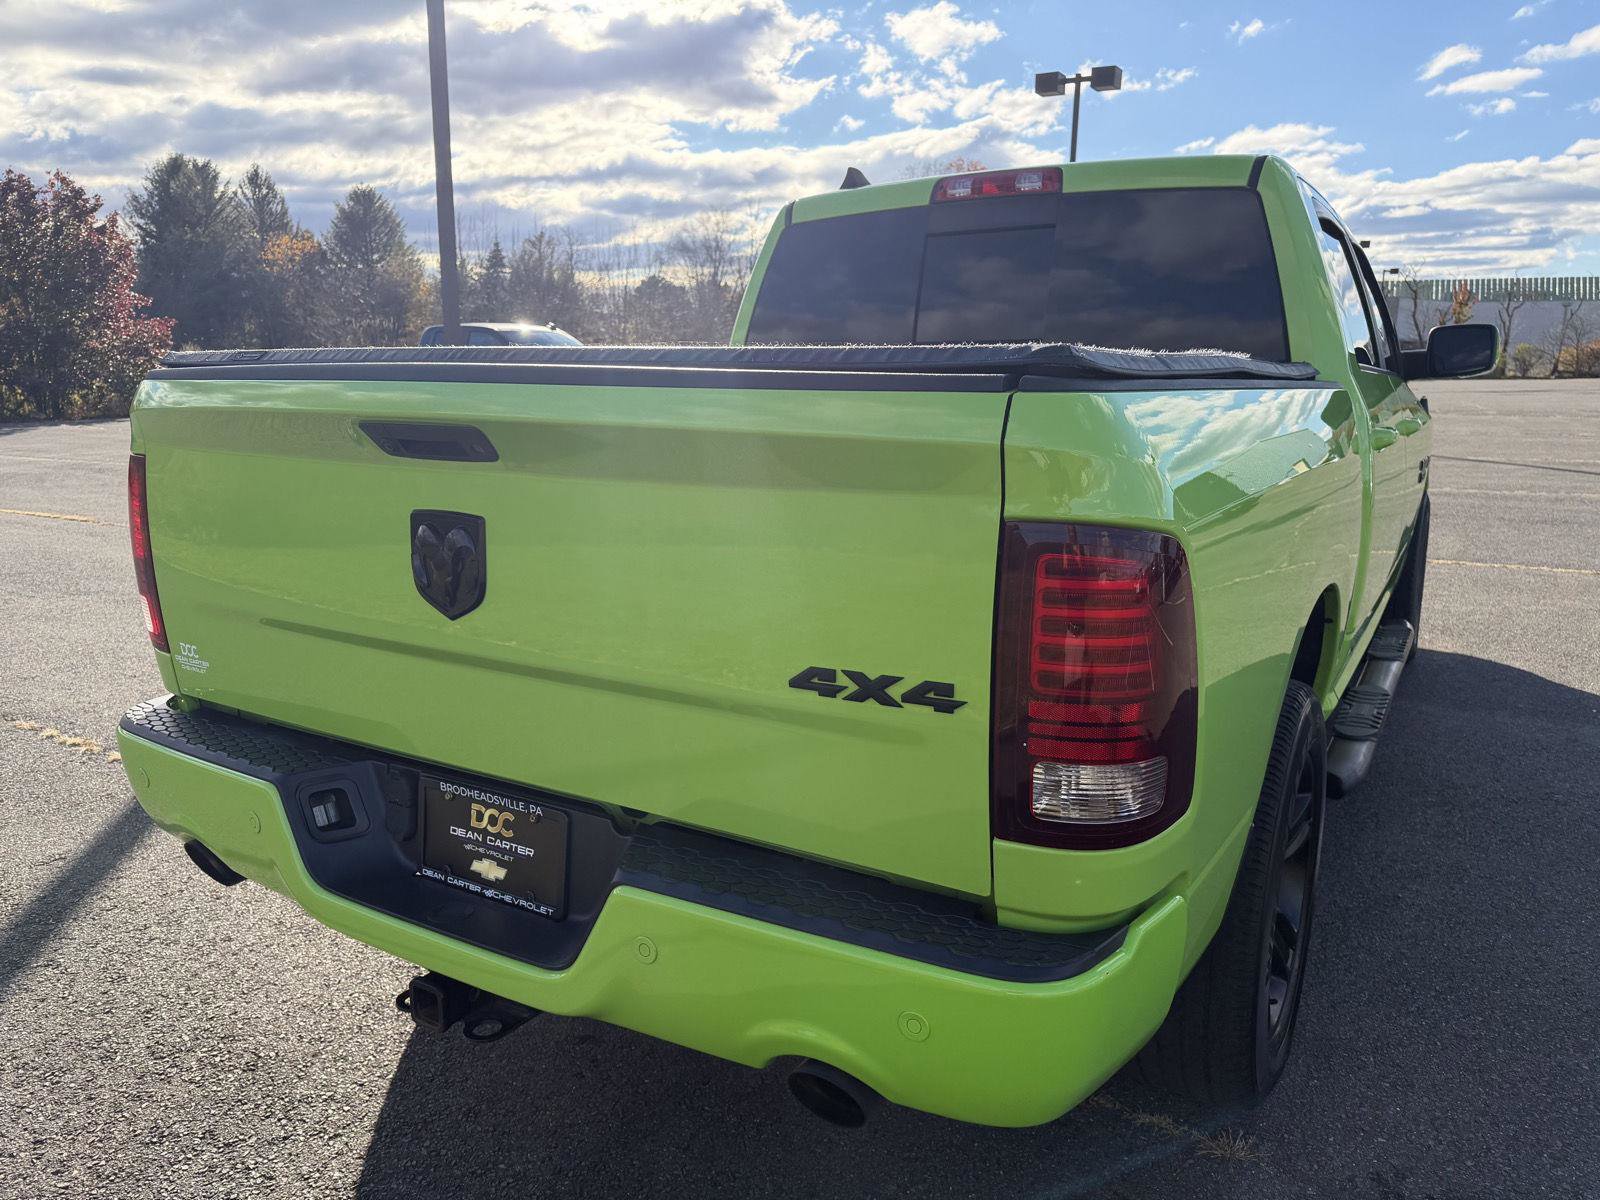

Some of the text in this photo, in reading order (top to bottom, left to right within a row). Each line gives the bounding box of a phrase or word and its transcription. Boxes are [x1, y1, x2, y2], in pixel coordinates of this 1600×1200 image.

[440, 781, 543, 817] BRODHEADSVILLE, PA
[450, 825, 535, 857] DEAN CARTER
[469, 844, 514, 862] CHEVROLET
[422, 868, 555, 916] DEAN CARTER CHEVROLET
